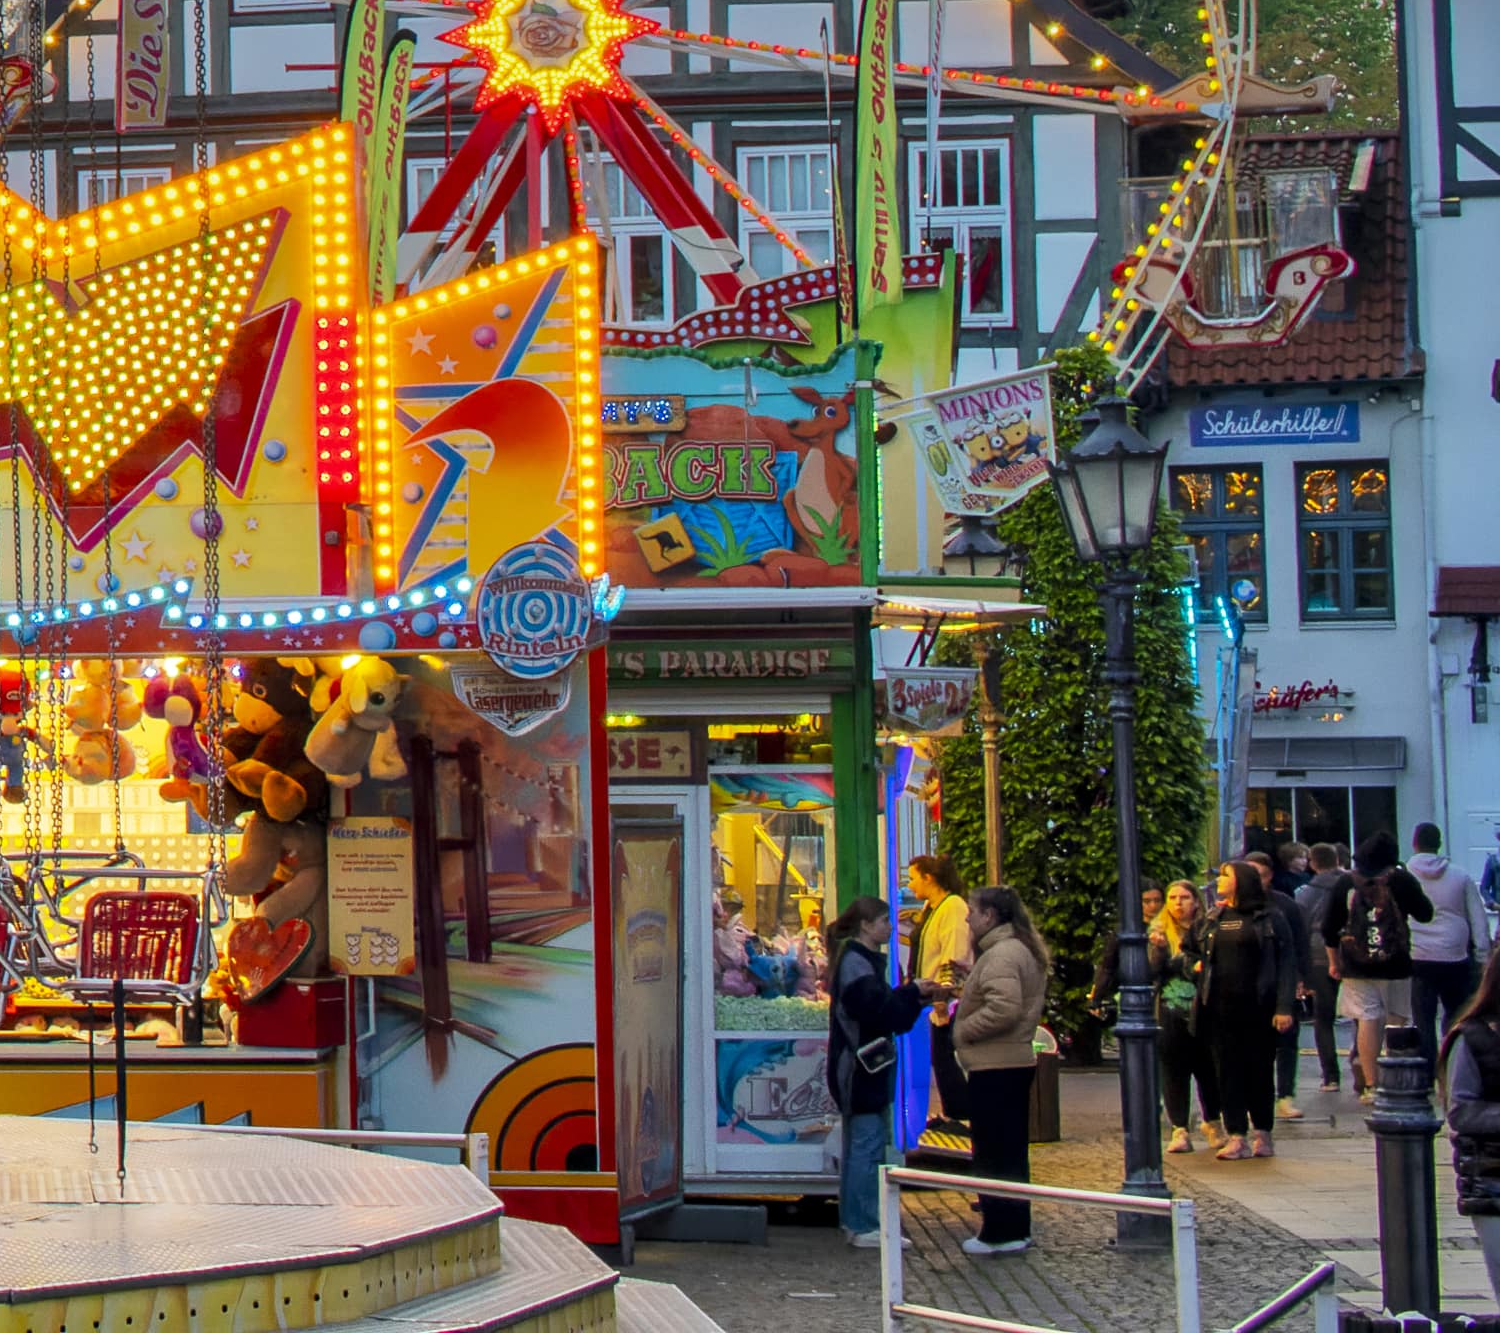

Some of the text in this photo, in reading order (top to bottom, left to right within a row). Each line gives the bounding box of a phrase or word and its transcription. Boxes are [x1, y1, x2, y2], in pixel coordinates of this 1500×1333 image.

[937, 378, 1045, 422] MINIONS
[487, 574, 586, 598] Willkommen
[487, 632, 584, 657] Rinteln
[658, 648, 831, 678] PARADISE
